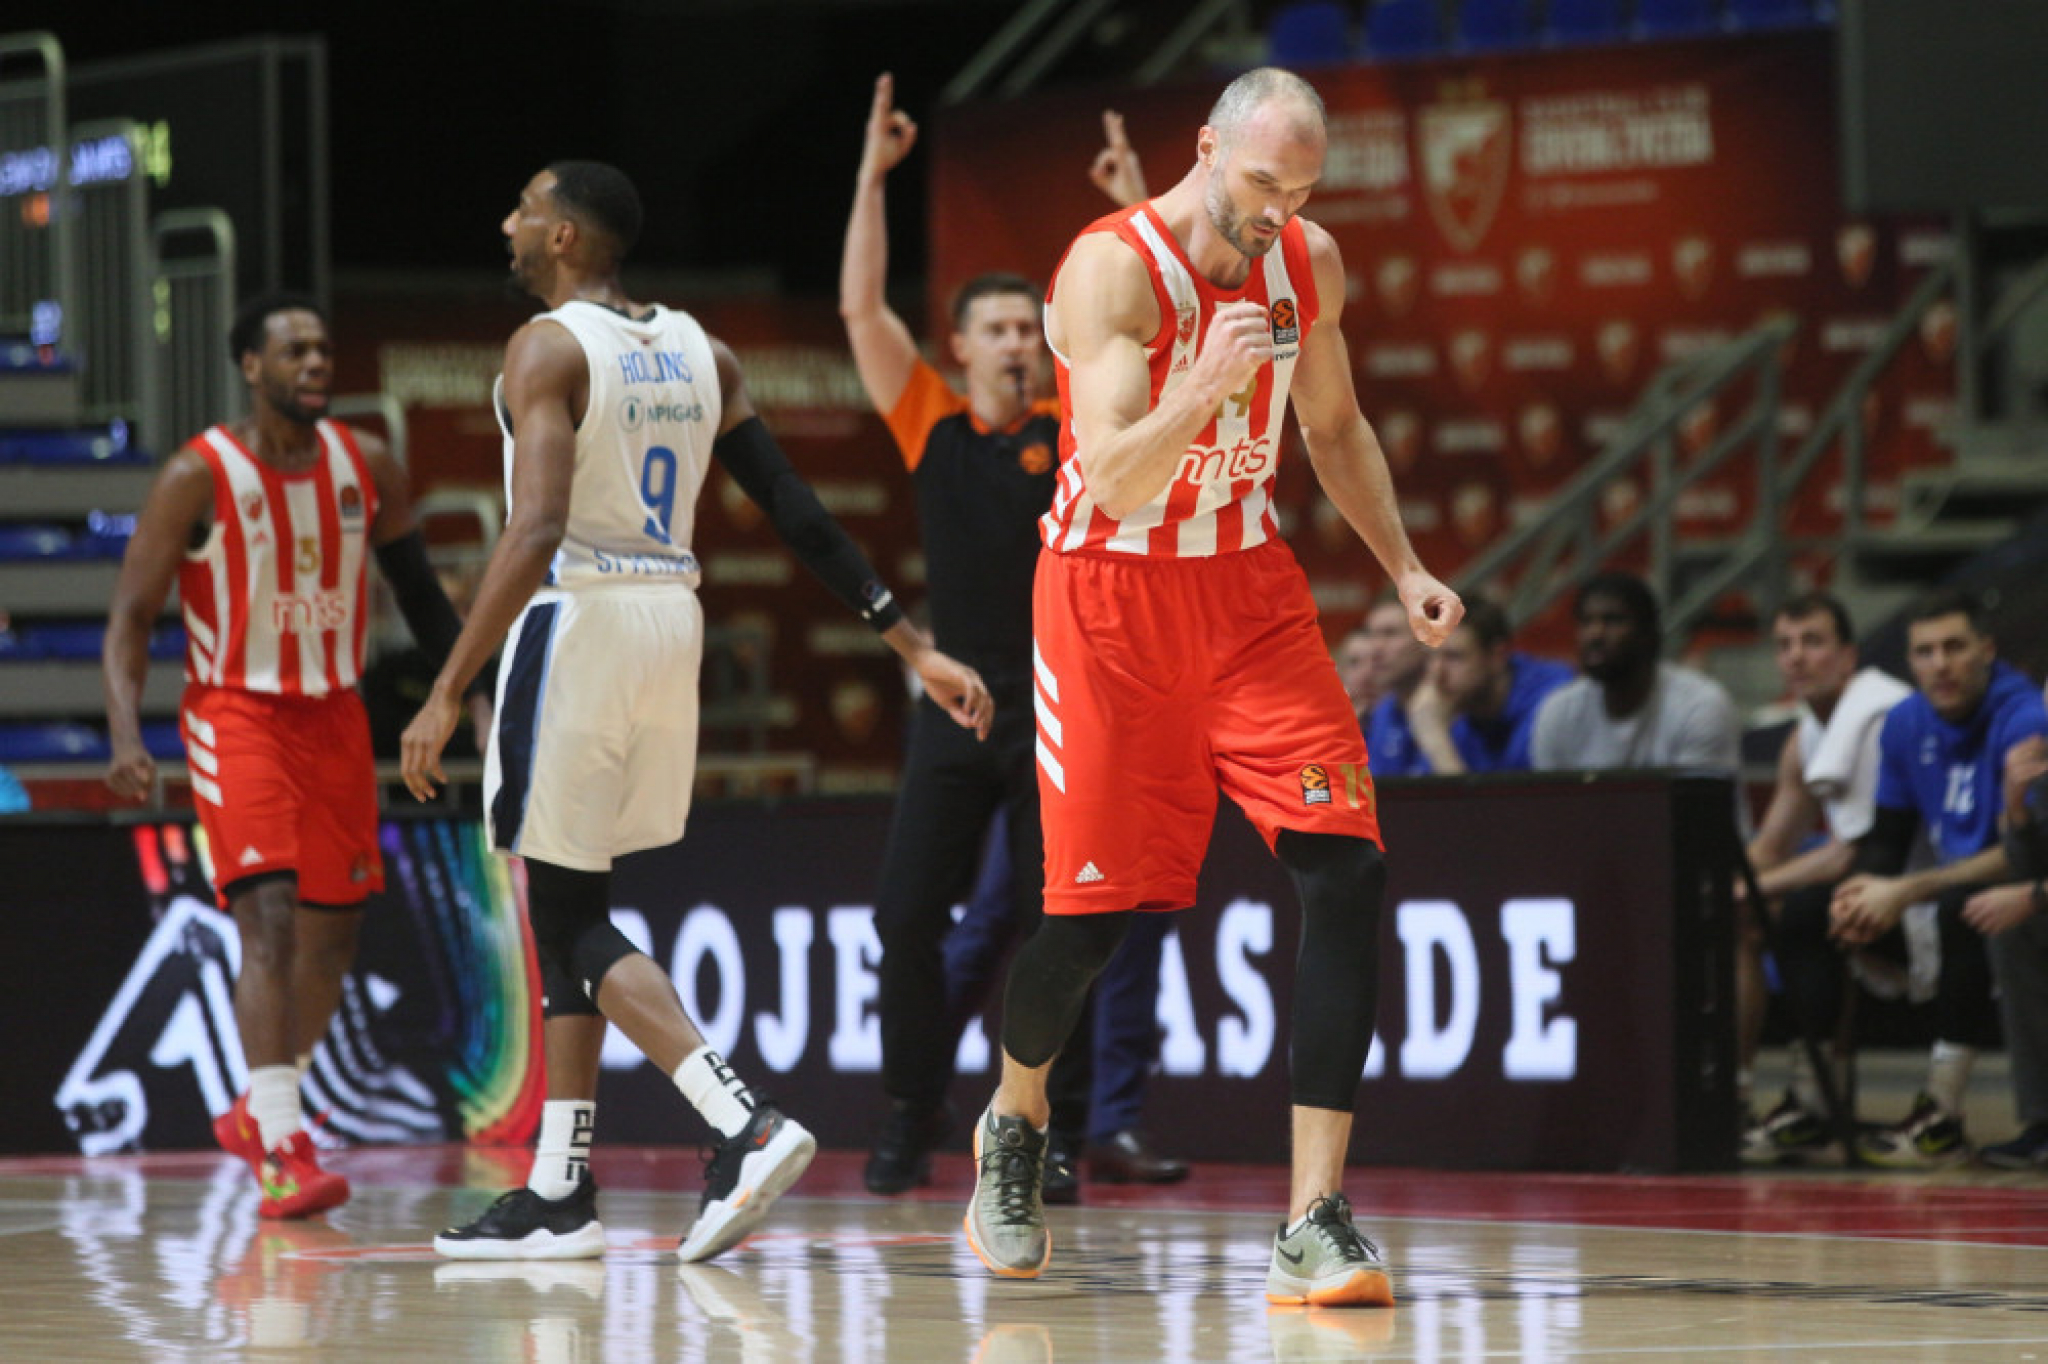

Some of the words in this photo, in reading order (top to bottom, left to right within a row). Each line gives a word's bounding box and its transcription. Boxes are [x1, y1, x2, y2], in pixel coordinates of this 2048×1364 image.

[1183, 437, 1271, 482] mts
[640, 445, 678, 545] 9
[296, 538, 320, 575] 3
[272, 591, 347, 630] mts
